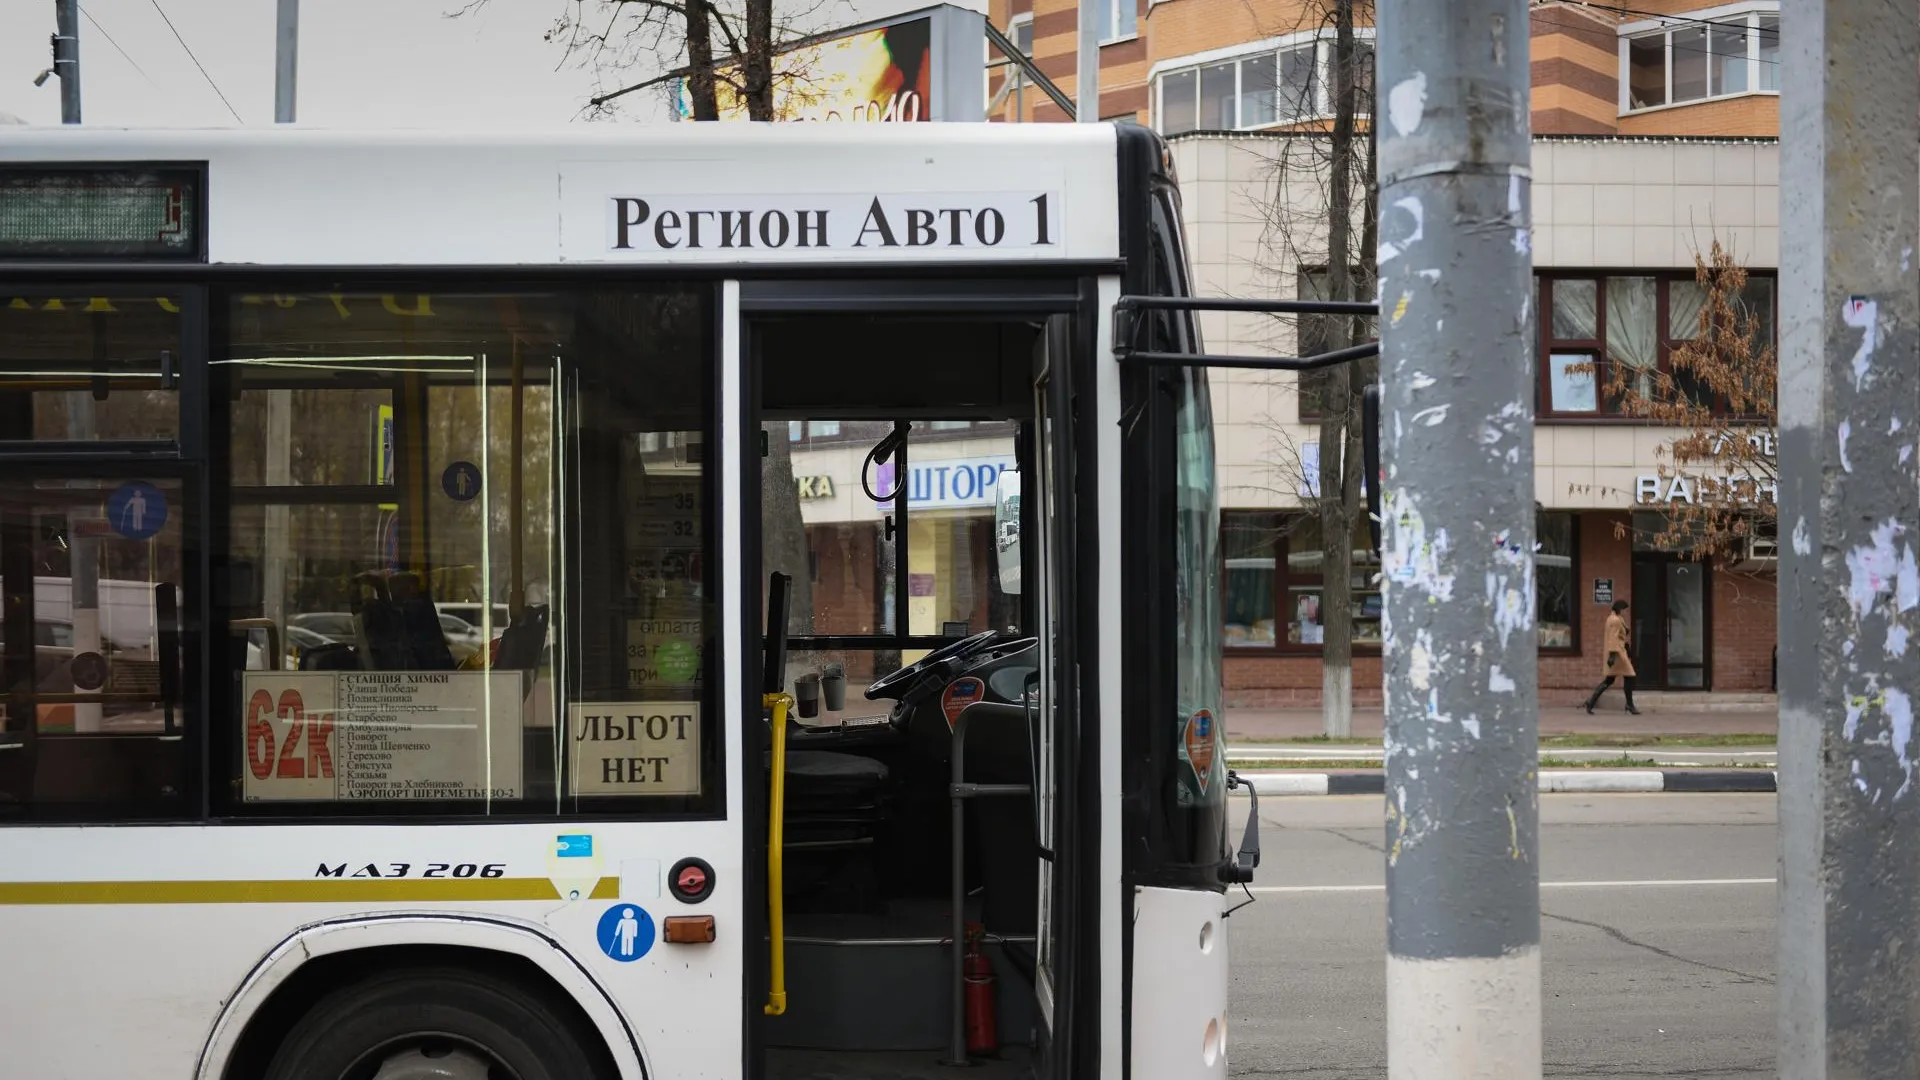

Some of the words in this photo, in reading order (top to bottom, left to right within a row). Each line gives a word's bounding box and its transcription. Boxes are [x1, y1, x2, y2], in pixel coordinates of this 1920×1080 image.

[610, 197, 830, 249] Регион
[851, 195, 1005, 247] Авто
[1028, 192, 1055, 246] 1
[799, 475, 835, 497] КА
[907, 463, 1004, 500] ШТОР
[347, 675, 401, 684] СТАНЦИЯ
[407, 674, 449, 684] ХИМКИ
[576, 715, 692, 742] ЛЬГОТ
[601, 757, 669, 784] НЕТ
[347, 788, 411, 799] АЭРОПОРТ
[423, 863, 506, 878] 206
